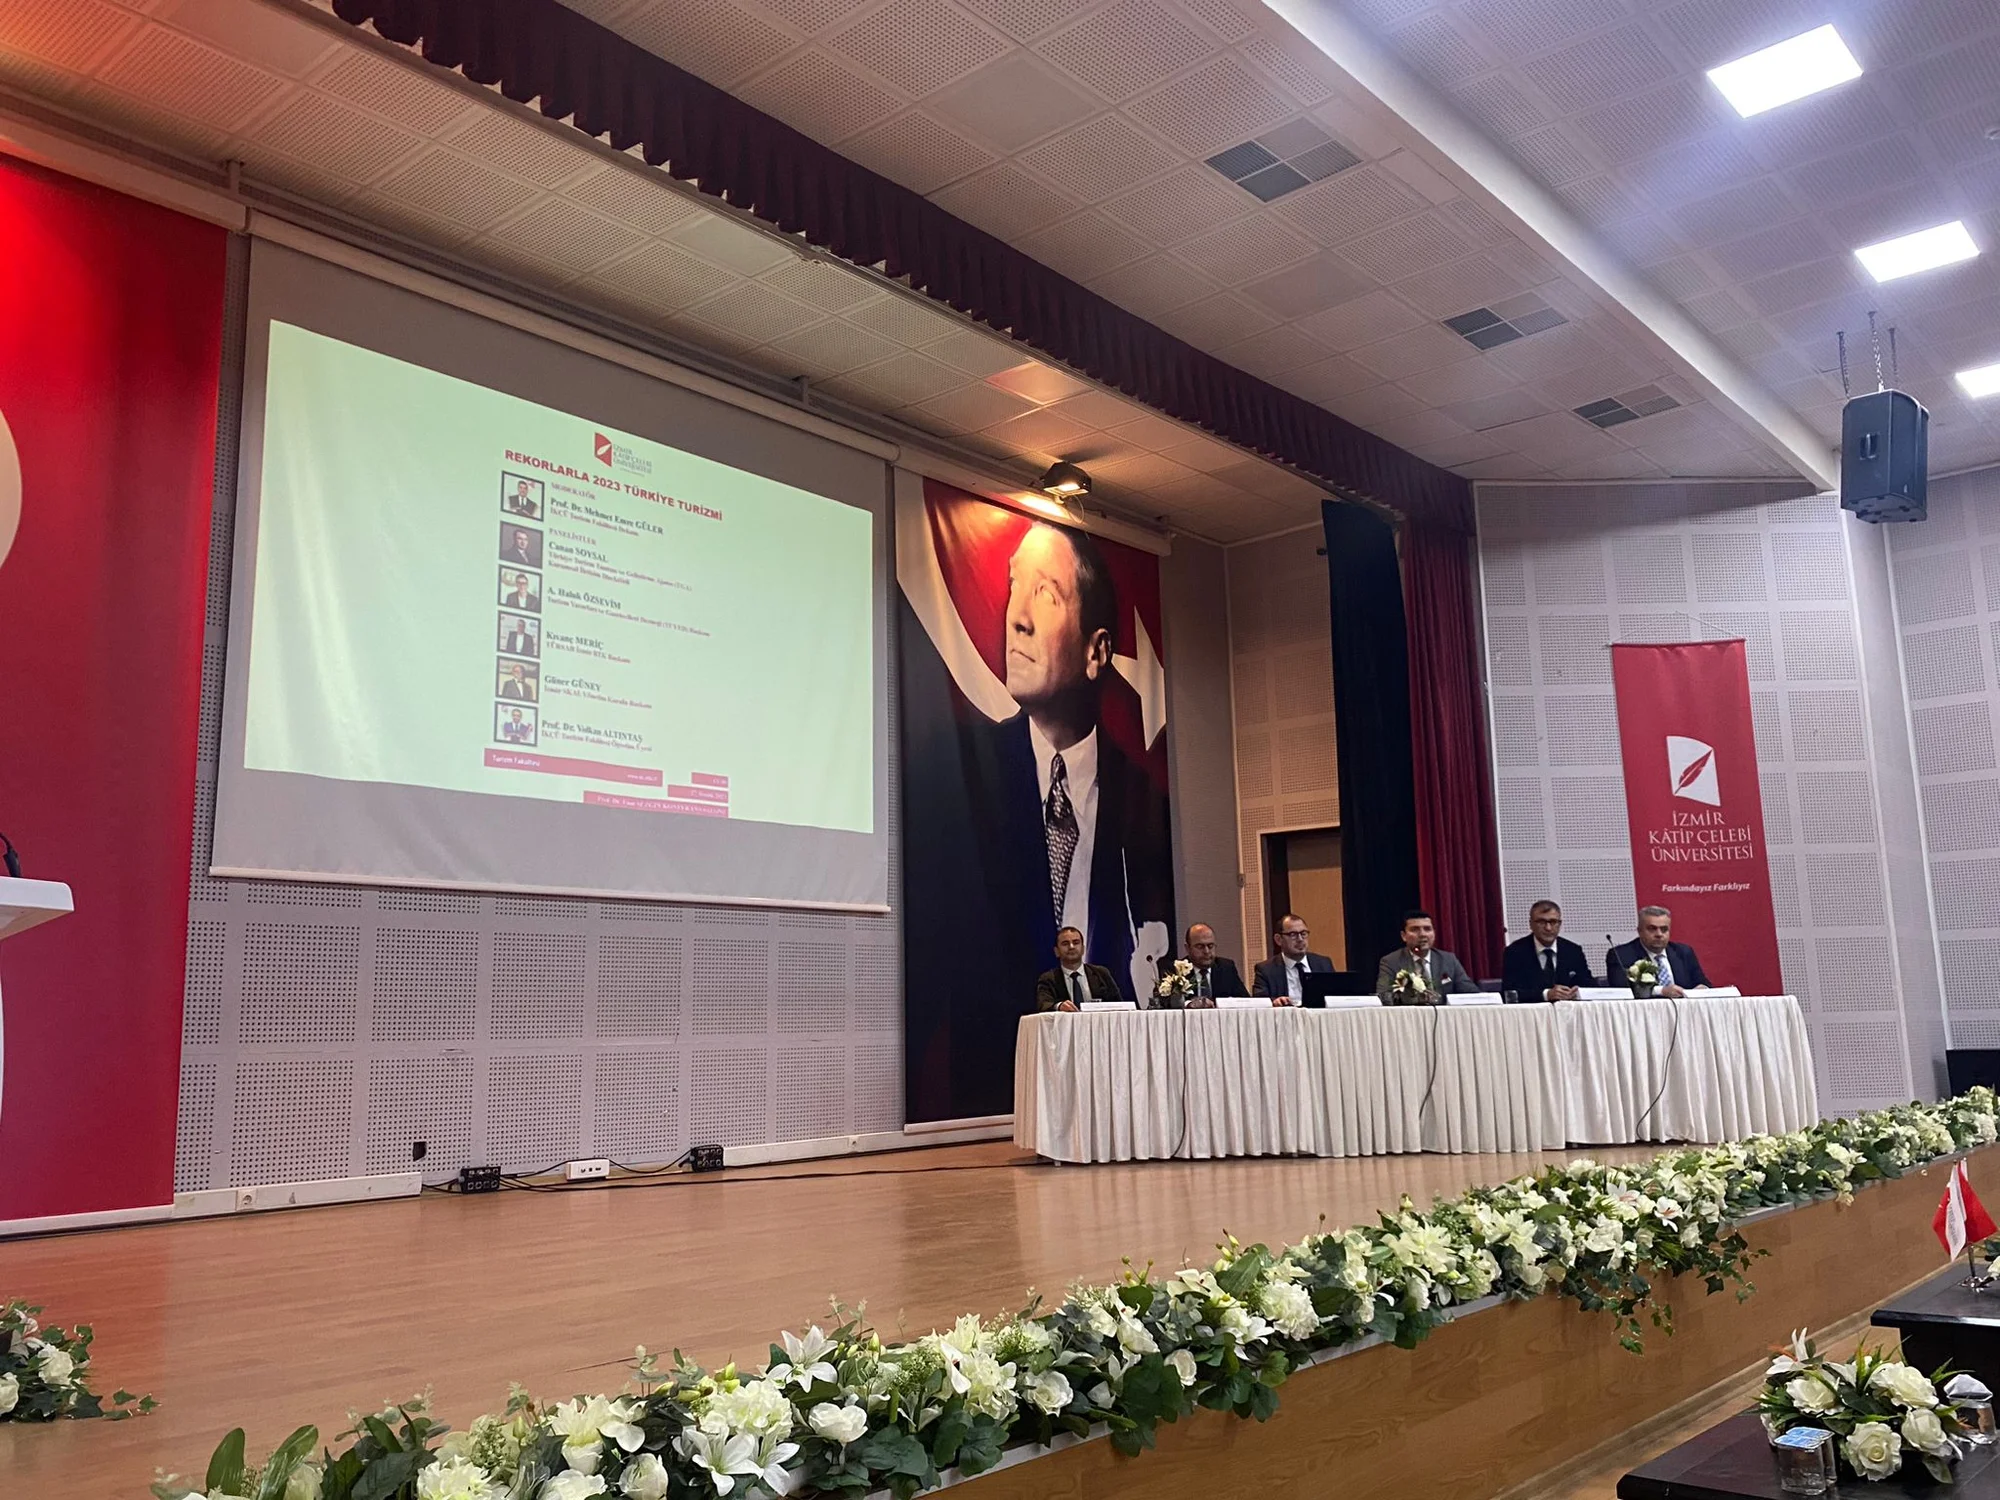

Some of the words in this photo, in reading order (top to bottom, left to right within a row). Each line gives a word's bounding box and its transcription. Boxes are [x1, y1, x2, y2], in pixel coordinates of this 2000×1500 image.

[505, 450, 590, 482] REKORLARLA
[593, 475, 621, 492] 2023
[624, 483, 675, 507] TÜRKİYE
[678, 500, 723, 521] TURİZMİ
[550, 497, 569, 509] Prof.
[571, 502, 582, 512] Dr.
[584, 506, 612, 521] Mehmet
[614, 515, 634, 527] Emre
[635, 520, 664, 535] GÜLER
[575, 547, 608, 563] SOYSAL
[547, 586, 556, 595] A.
[558, 588, 582, 600] Haluk
[583, 592, 622, 610] ÖZSEVİM
[546, 631, 574, 644] Kıvanç
[575, 636, 604, 650] MERİÇ
[544, 675, 570, 686] Güner
[571, 678, 602, 692] GÜNEY
[542, 720, 560, 730] Prof.
[563, 723, 575, 732] Dr.
[576, 724, 602, 736] Volkan
[603, 730, 644, 744] ALTINTAŞ
[1672, 810, 1725, 826] İZMİR
[1649, 828, 1694, 844] KÂTİP
[1697, 825, 1752, 846] ÇELEBİ
[1652, 842, 1754, 862] ÜNİVERSİTESİ
[1662, 884, 1712, 894] Farkındayız
[1713, 882, 1750, 892] Farklıyız
